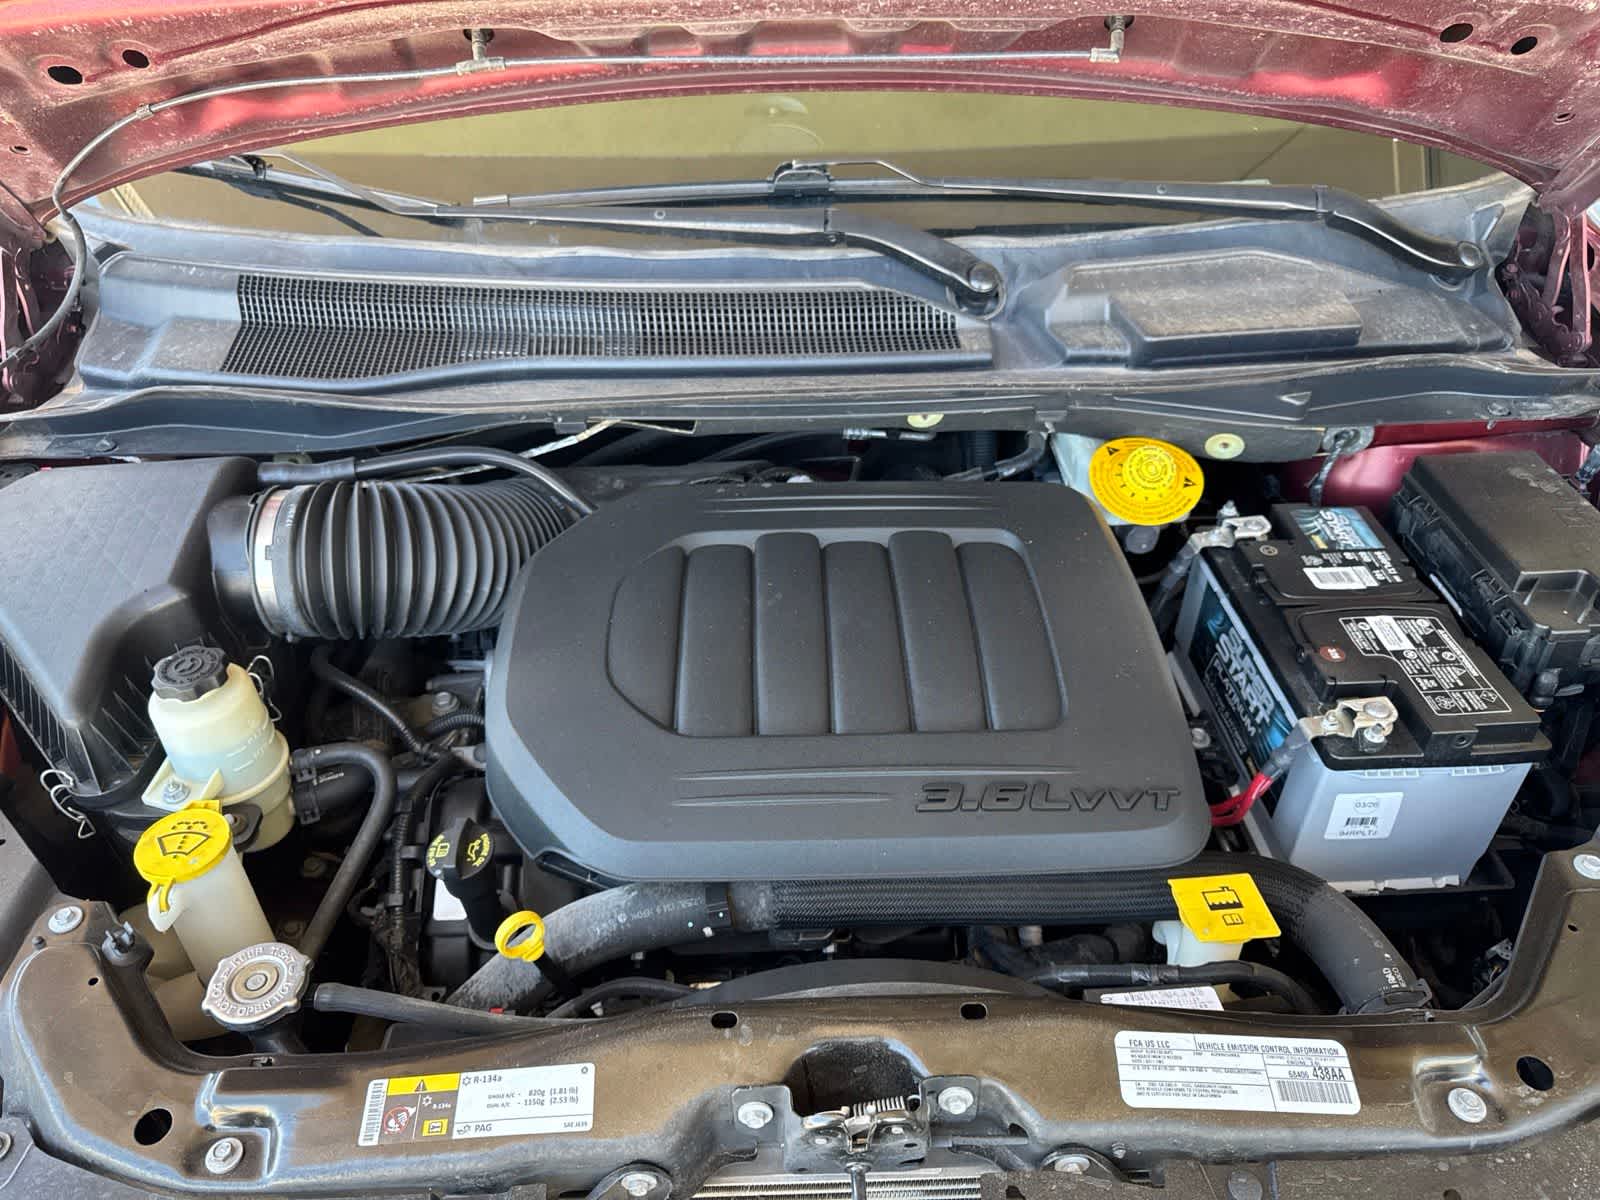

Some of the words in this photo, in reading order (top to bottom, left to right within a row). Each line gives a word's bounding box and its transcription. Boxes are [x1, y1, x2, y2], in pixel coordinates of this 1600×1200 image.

[1228, 626, 1275, 716] SUPER
[1215, 632, 1271, 726] START
[1213, 659, 1256, 737] PLATINUM
[915, 781, 1071, 813] 3.6L
[1069, 787, 1181, 813] VVT
[480, 833, 491, 857] ENGINE
[237, 1000, 273, 1017] OPEN
[1129, 1039, 1143, 1048] FCA
[1144, 1039, 1156, 1048] US
[1157, 1040, 1171, 1049] LLC
[1197, 1041, 1226, 1051] VEHICLE
[1226, 1043, 1260, 1053] EMISSION
[1260, 1044, 1292, 1054] CONTROL
[1293, 1046, 1340, 1056] INFORMATION
[473, 1074, 502, 1084] R-134a
[1312, 1066, 1346, 1081] 438AA
[528, 1088, 546, 1097] 820g
[549, 1086, 568, 1097] (1.81
[568, 1085, 579, 1096] lb)
[524, 1098, 545, 1107] 1150g
[549, 1096, 569, 1106] (2.53
[568, 1094, 580, 1105] lb)
[474, 1123, 493, 1133] PAG
